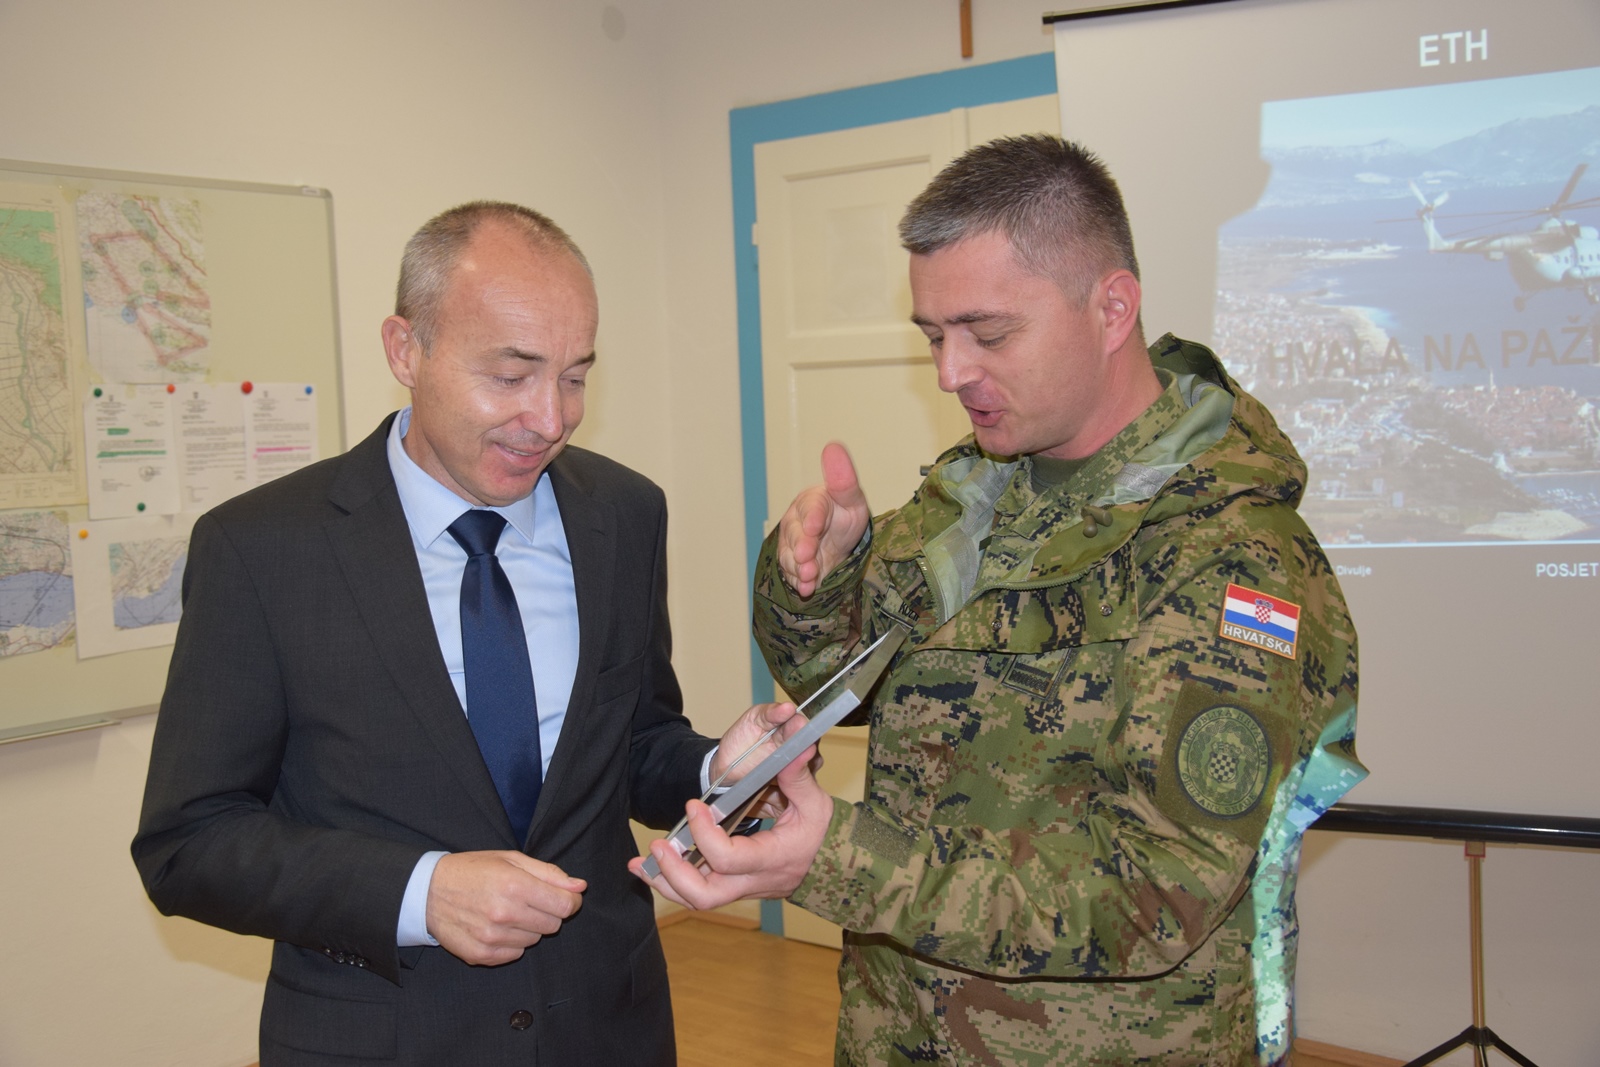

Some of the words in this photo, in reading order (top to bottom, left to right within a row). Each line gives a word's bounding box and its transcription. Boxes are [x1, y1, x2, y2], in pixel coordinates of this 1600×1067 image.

[1419, 28, 1488, 68] ETH
[1267, 336, 1410, 380] HVALA
[1423, 332, 1488, 373] NA
[1535, 562, 1600, 577] POSJET
[1223, 624, 1293, 656] HRVATSKA
[1183, 709, 1233, 745] REPUBLIKA
